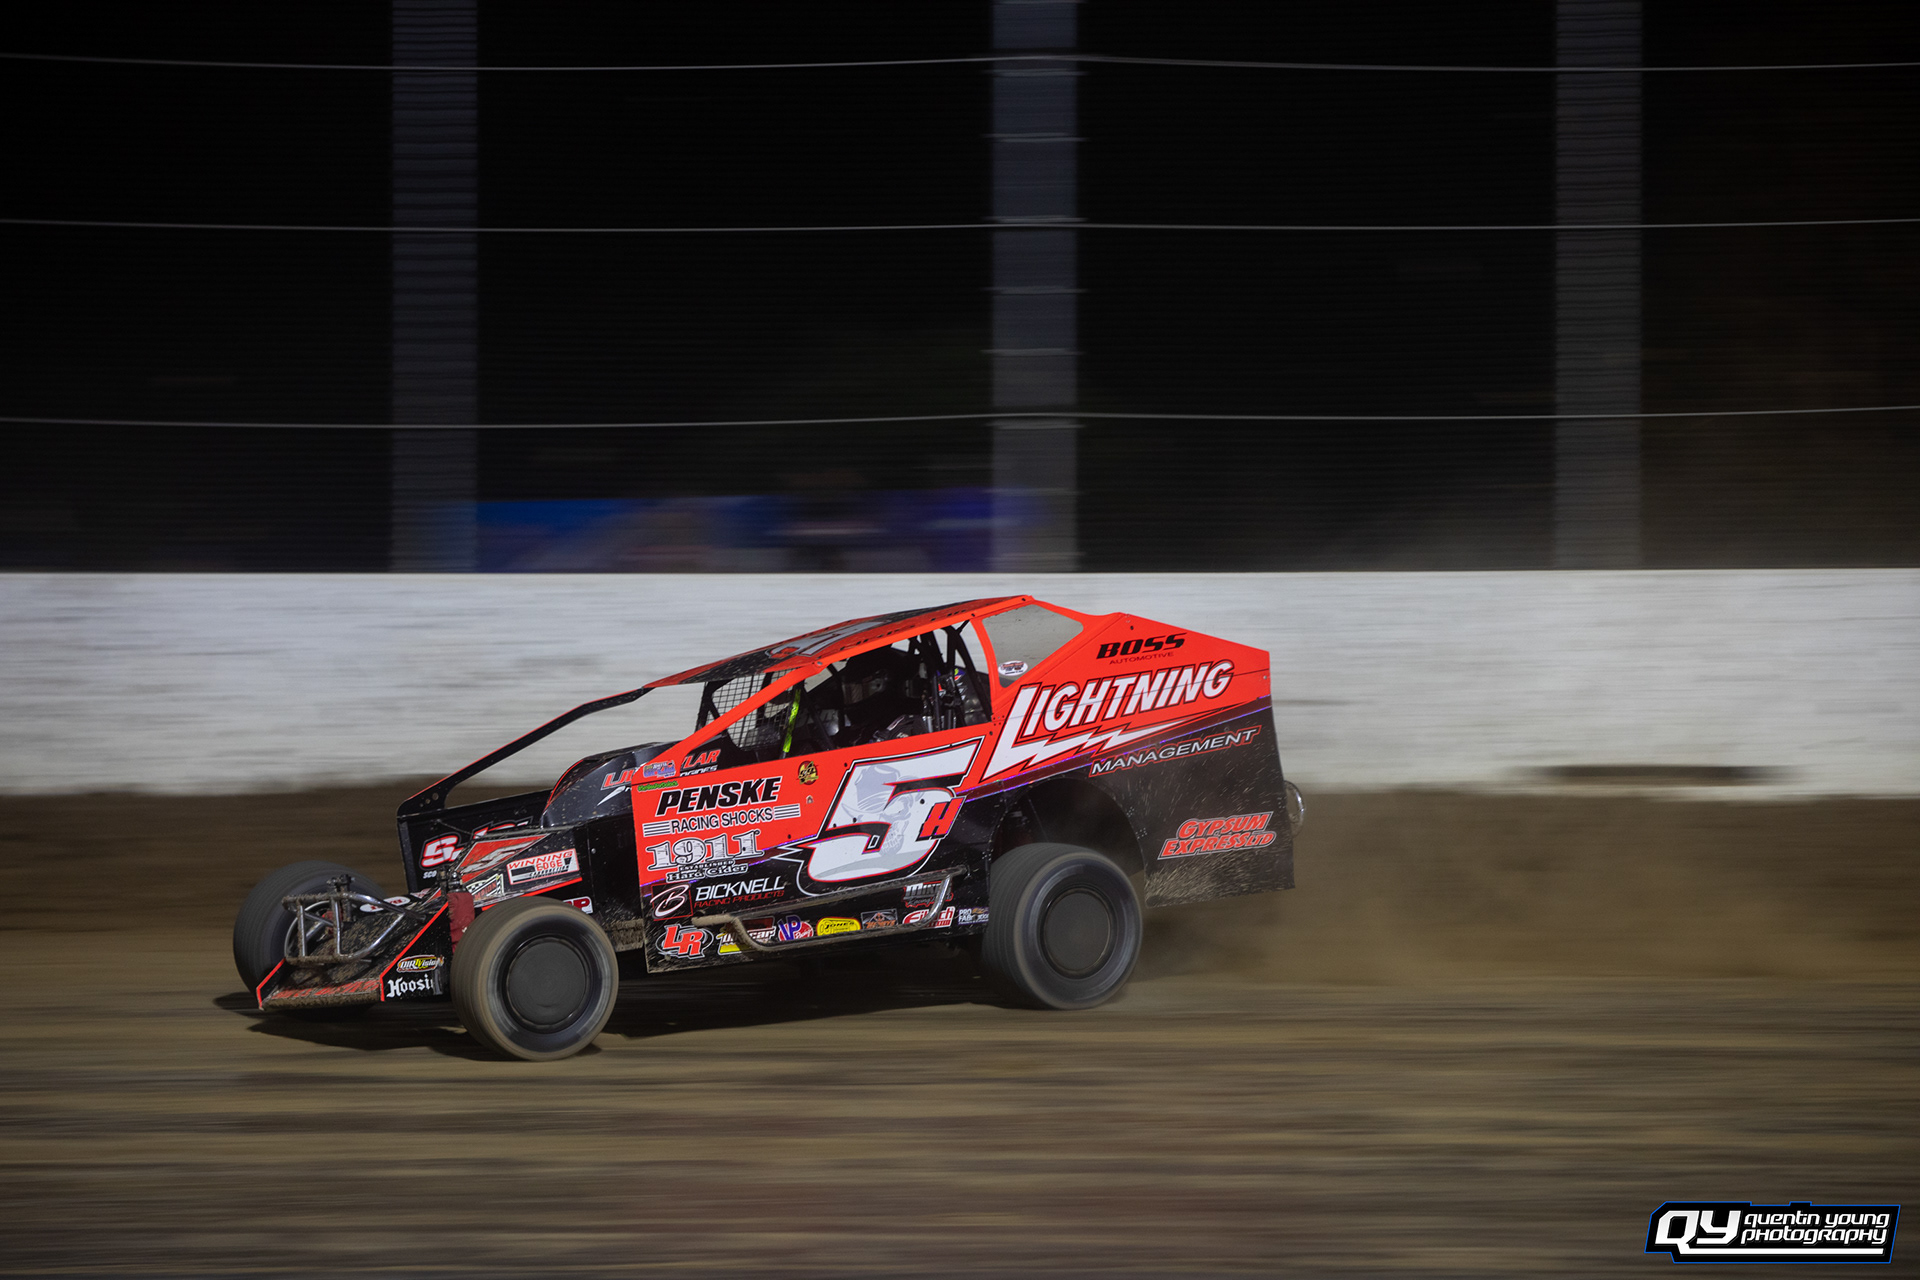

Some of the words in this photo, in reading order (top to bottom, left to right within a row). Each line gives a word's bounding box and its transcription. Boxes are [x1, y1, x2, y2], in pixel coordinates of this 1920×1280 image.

[1096, 633, 1188, 660] BOSS
[1109, 651, 1175, 665] AUTOMOTIVE
[981, 660, 1235, 782] LIGHTNING
[1090, 728, 1260, 776] MANAGEMENT
[655, 776, 783, 817] PENSKE
[671, 816, 721, 834] RACING
[721, 807, 774, 831] SHOCKS
[1178, 813, 1271, 840] GYPSUM
[646, 829, 764, 871] 1911
[1160, 832, 1252, 857] EXPRESS
[1249, 833, 1275, 846] LTD
[508, 851, 573, 869] WINNING
[536, 858, 563, 872] EDGE
[667, 870, 703, 882] Hard
[706, 864, 748, 876] Cider
[693, 896, 731, 909] RACING
[732, 890, 785, 904] PRODUCTS
[695, 876, 786, 902] BICKNELL
[663, 924, 704, 956] LR
[778, 916, 802, 942] VP
